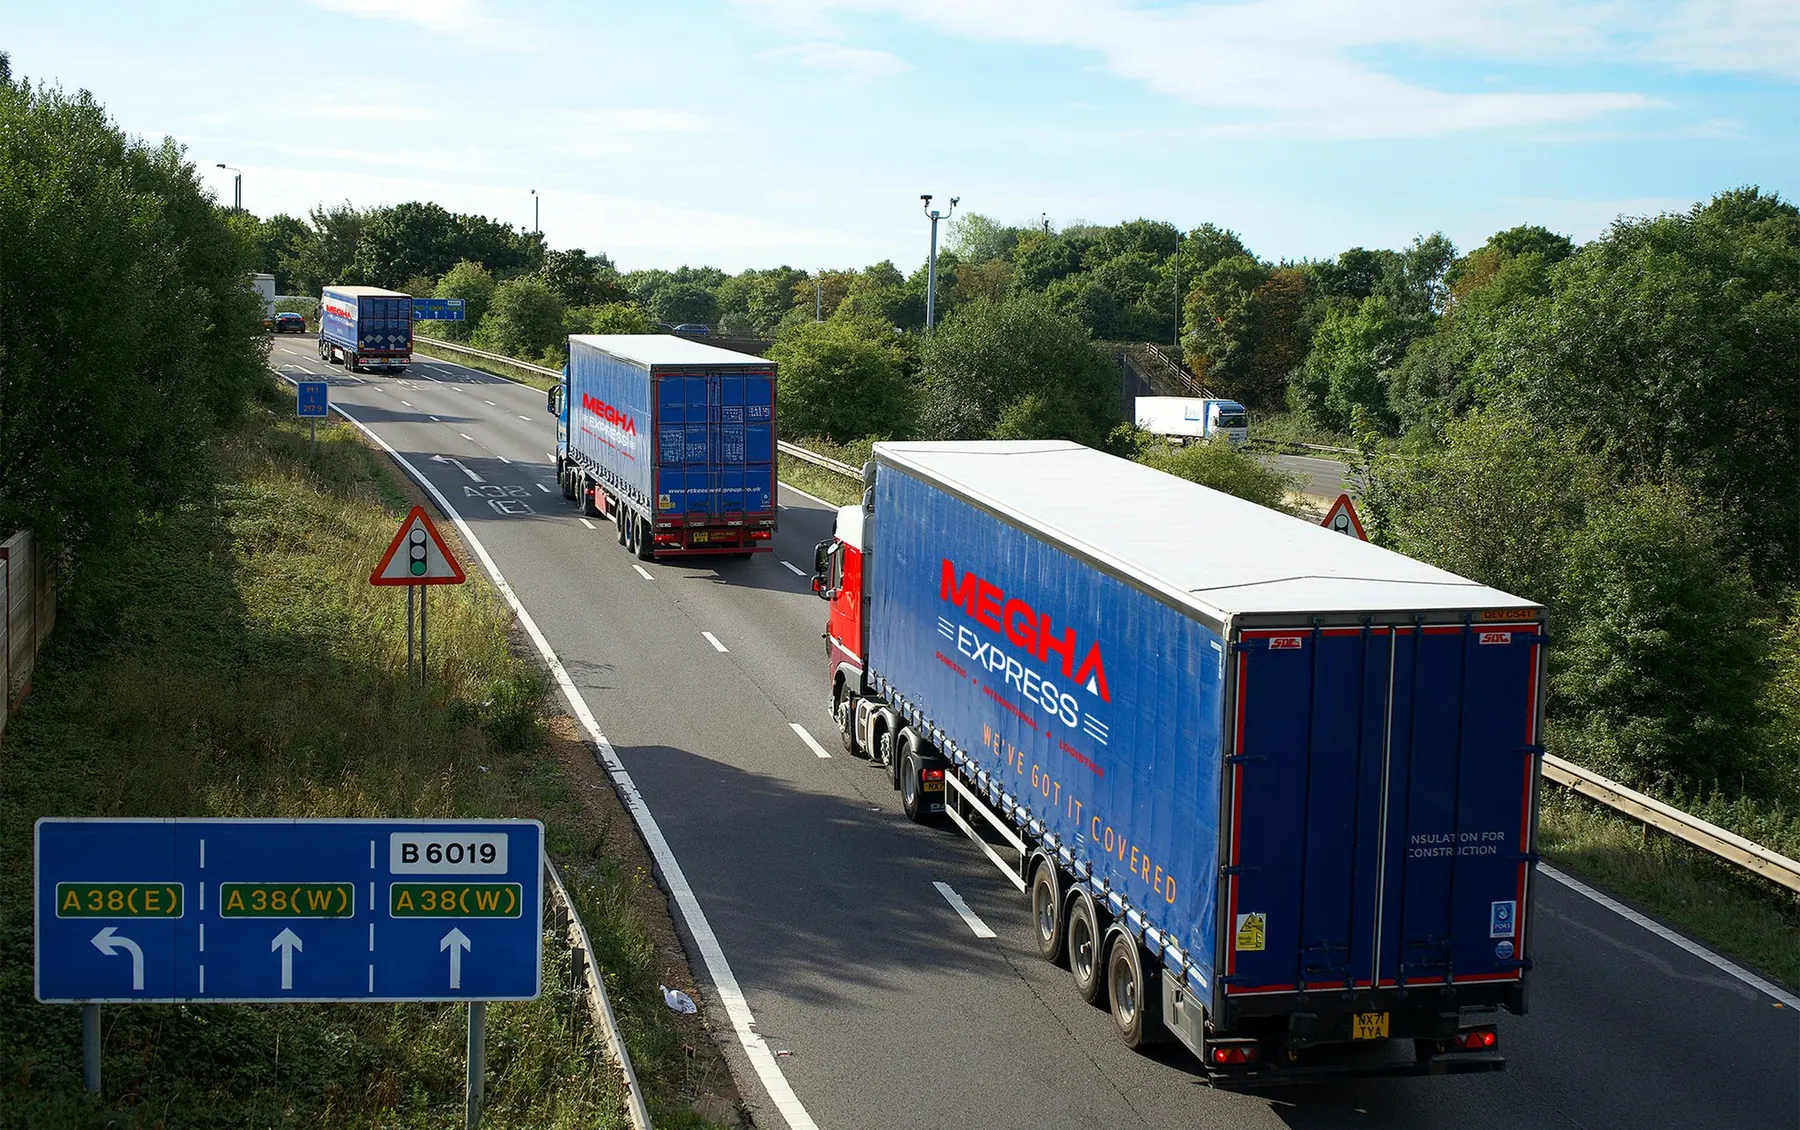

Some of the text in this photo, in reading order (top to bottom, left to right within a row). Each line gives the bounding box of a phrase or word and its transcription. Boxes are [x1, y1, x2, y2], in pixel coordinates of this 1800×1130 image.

[583, 392, 636, 436] MEGHA
[940, 557, 1111, 704] MEGHA
[1484, 609, 1532, 619] DEV C541
[957, 624, 1078, 728] EXPRESS
[983, 723, 1176, 904] WE'VE GOT IT COVERED
[1482, 831, 1505, 841] FOR
[1360, 1026, 1382, 1037] TYA
